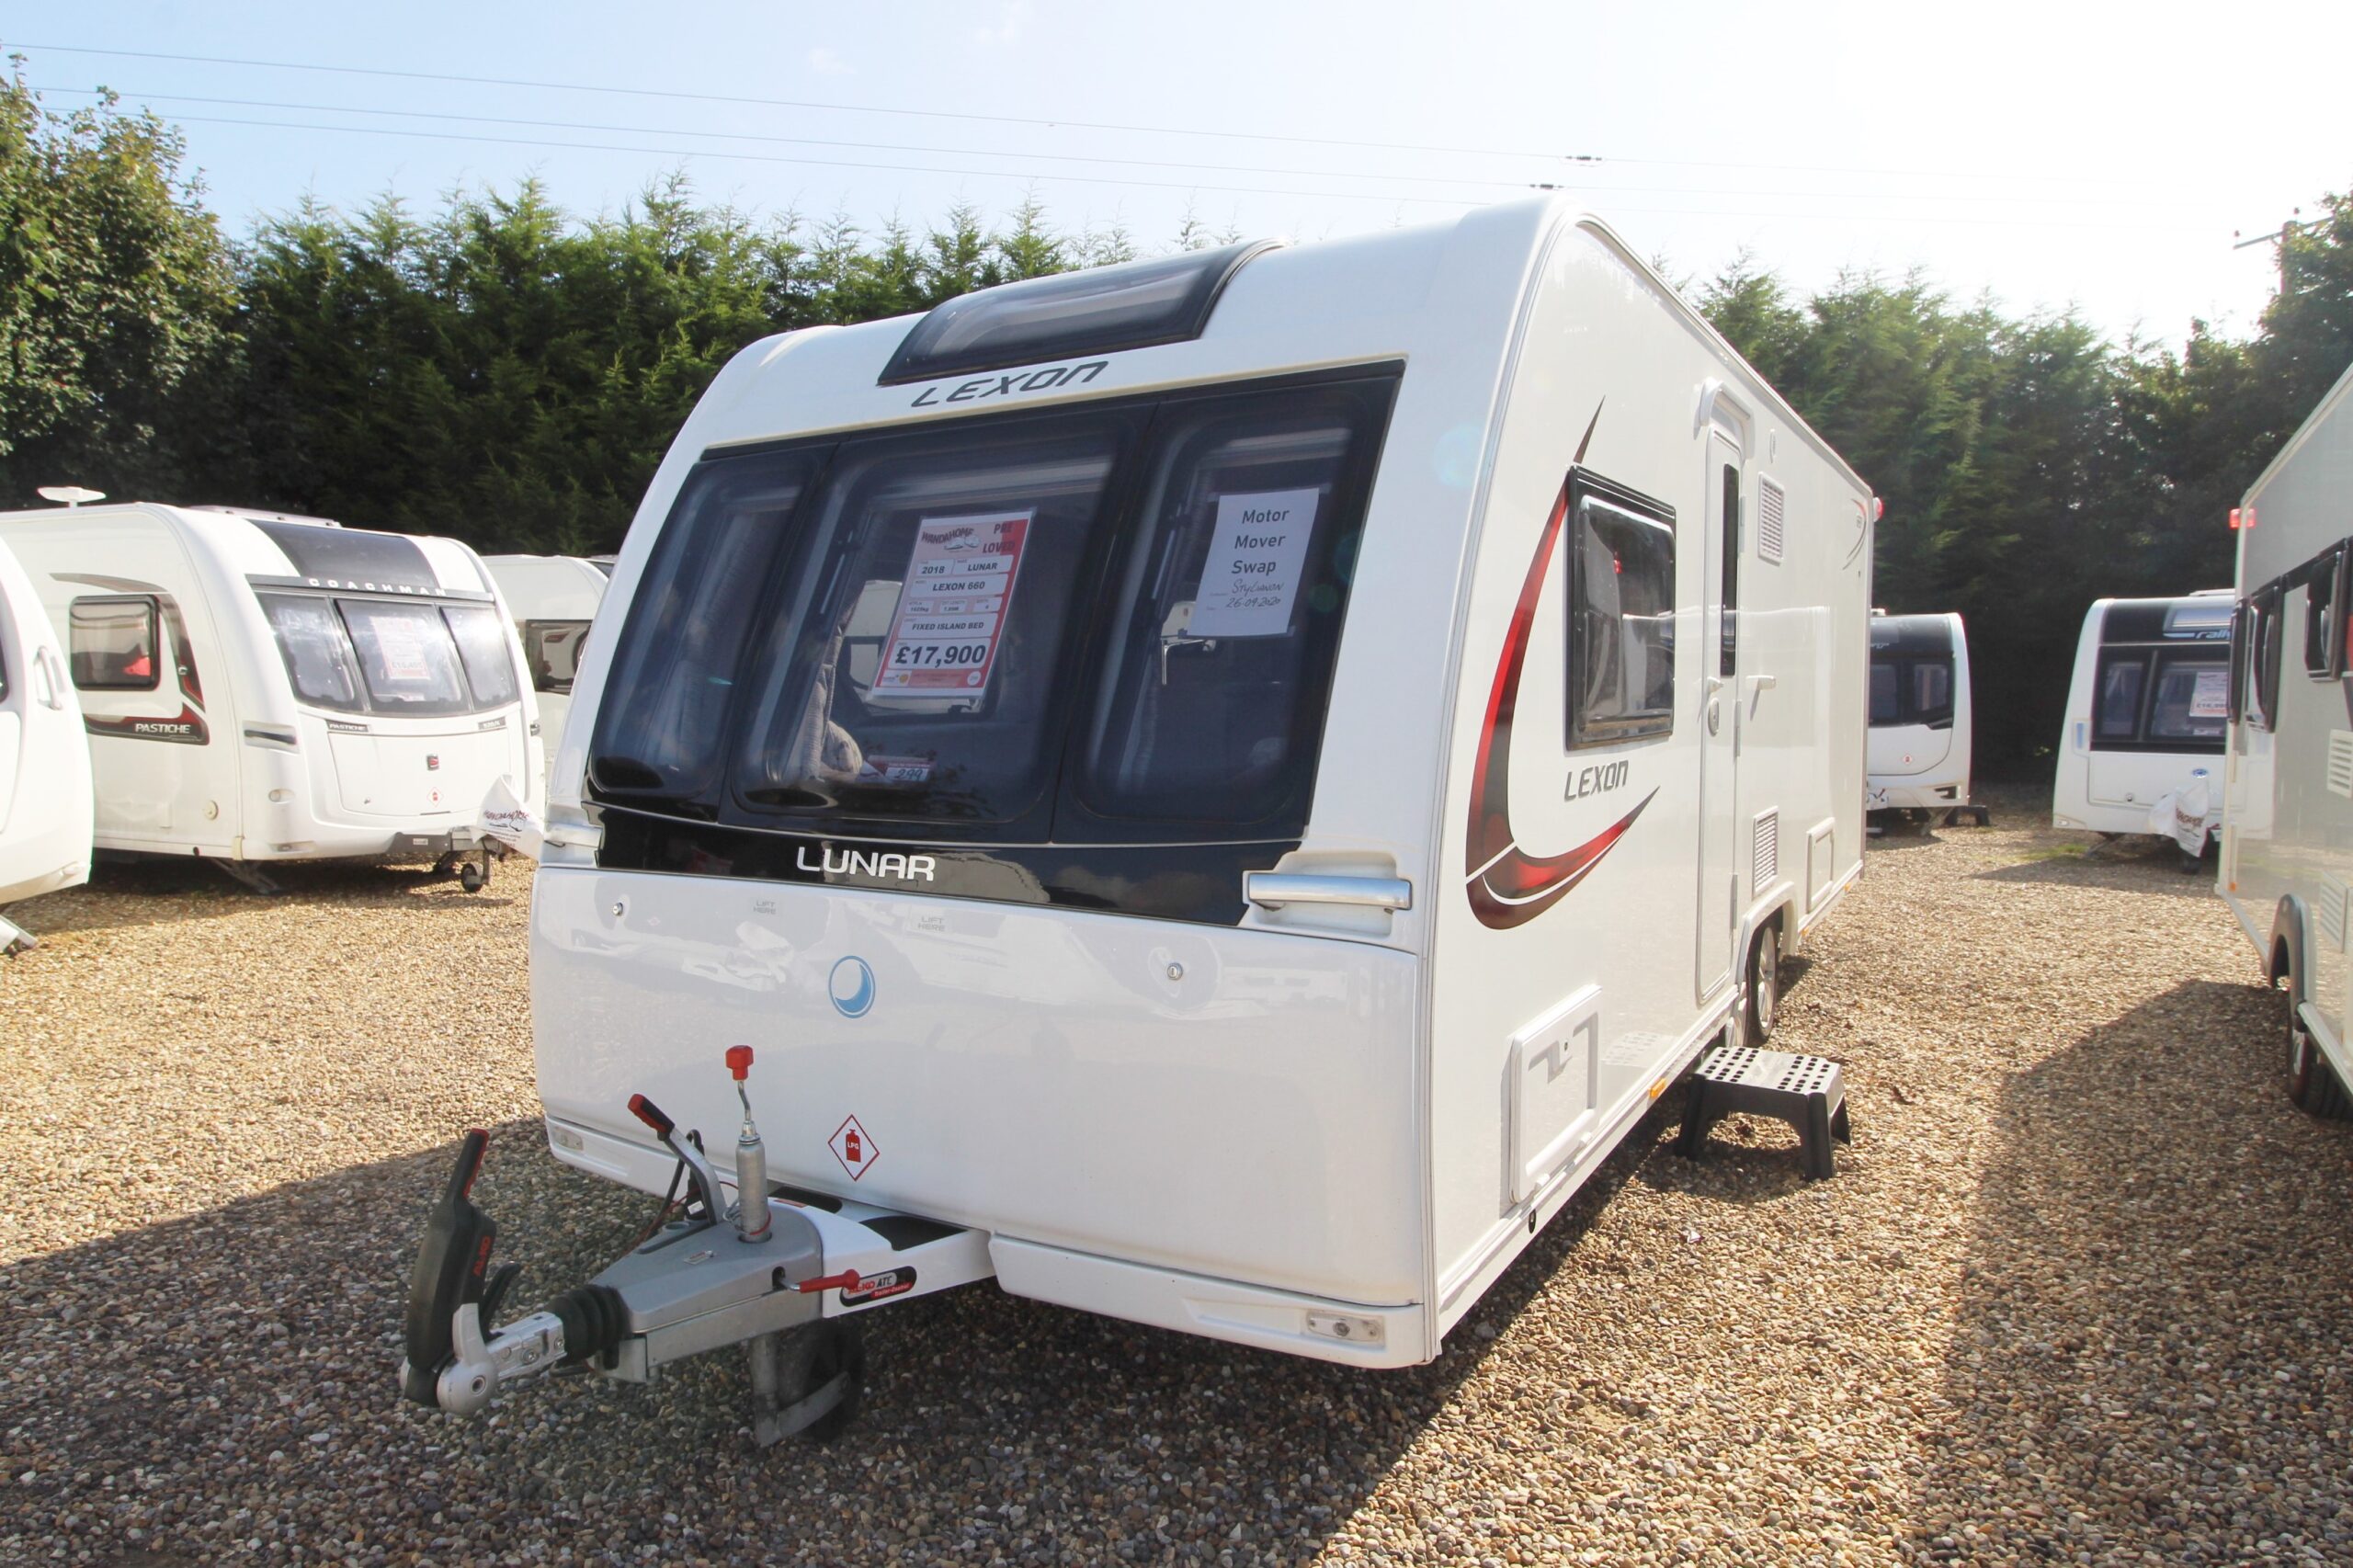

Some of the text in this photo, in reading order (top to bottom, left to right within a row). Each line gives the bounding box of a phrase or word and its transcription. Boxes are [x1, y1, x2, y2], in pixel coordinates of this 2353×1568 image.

[911, 360, 1109, 408] LEXON
[1242, 508, 1290, 524] Motor
[921, 528, 974, 544] WANDAHOME
[994, 523, 1013, 534] PRE
[982, 541, 1016, 554] LOVED
[1234, 534, 1286, 550] Mover
[921, 562, 998, 574] 2018 LUNAR
[1231, 561, 1277, 576] Swap
[309, 577, 446, 596] COACHMAN
[932, 581, 985, 592] LEXON 660
[968, 621, 984, 630] BED
[895, 645, 986, 668] £17,900
[135, 722, 191, 733] PASTICHE
[1563, 759, 1629, 802] LEXON
[796, 846, 936, 881] LUNAR
[847, 1142, 859, 1151] LPG
[876, 1276, 892, 1288] ATC
